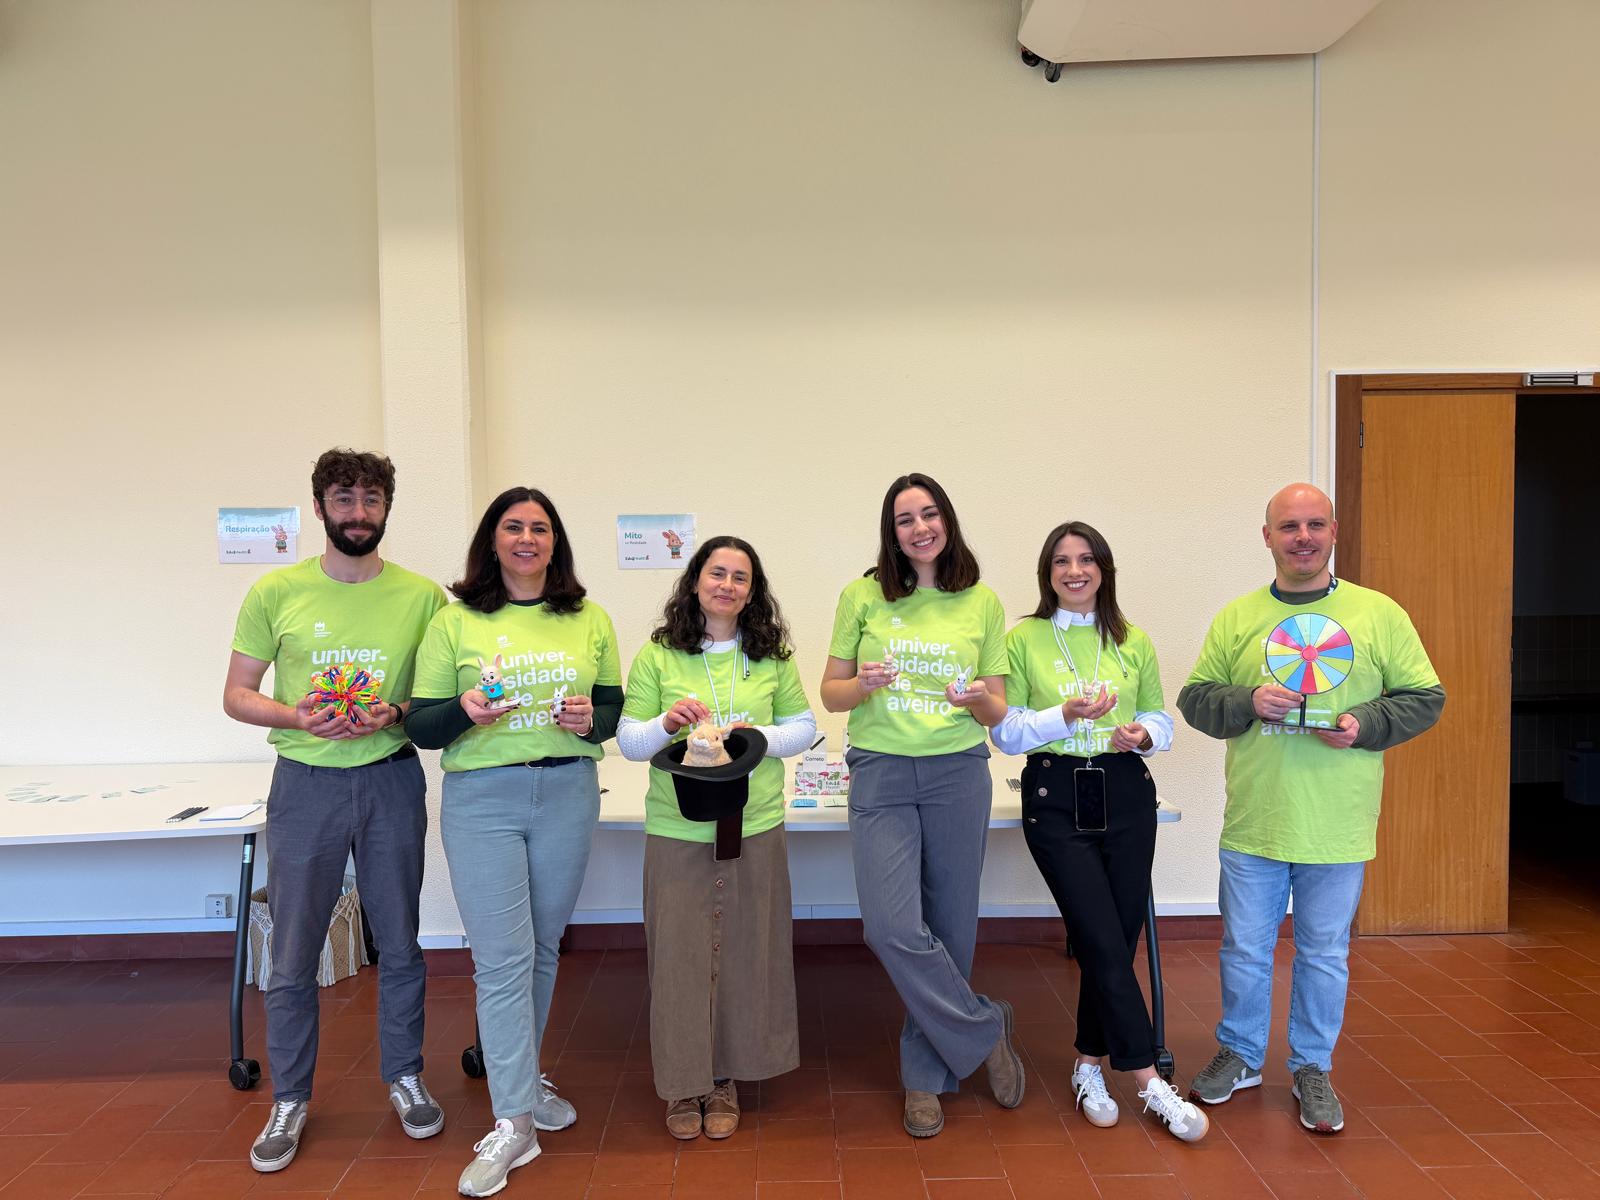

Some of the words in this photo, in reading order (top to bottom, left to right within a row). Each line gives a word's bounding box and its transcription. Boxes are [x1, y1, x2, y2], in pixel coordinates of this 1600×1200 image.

[225, 524, 270, 534] Respiração
[624, 532, 643, 540] Mito
[311, 644, 388, 665] univer-
[889, 636, 957, 657] univer-
[501, 649, 575, 669] univer-
[892, 655, 955, 677] sidade
[503, 662, 578, 690] sidade
[886, 696, 952, 717] aveiro
[508, 709, 555, 730] avei
[1063, 733, 1112, 753] aveir
